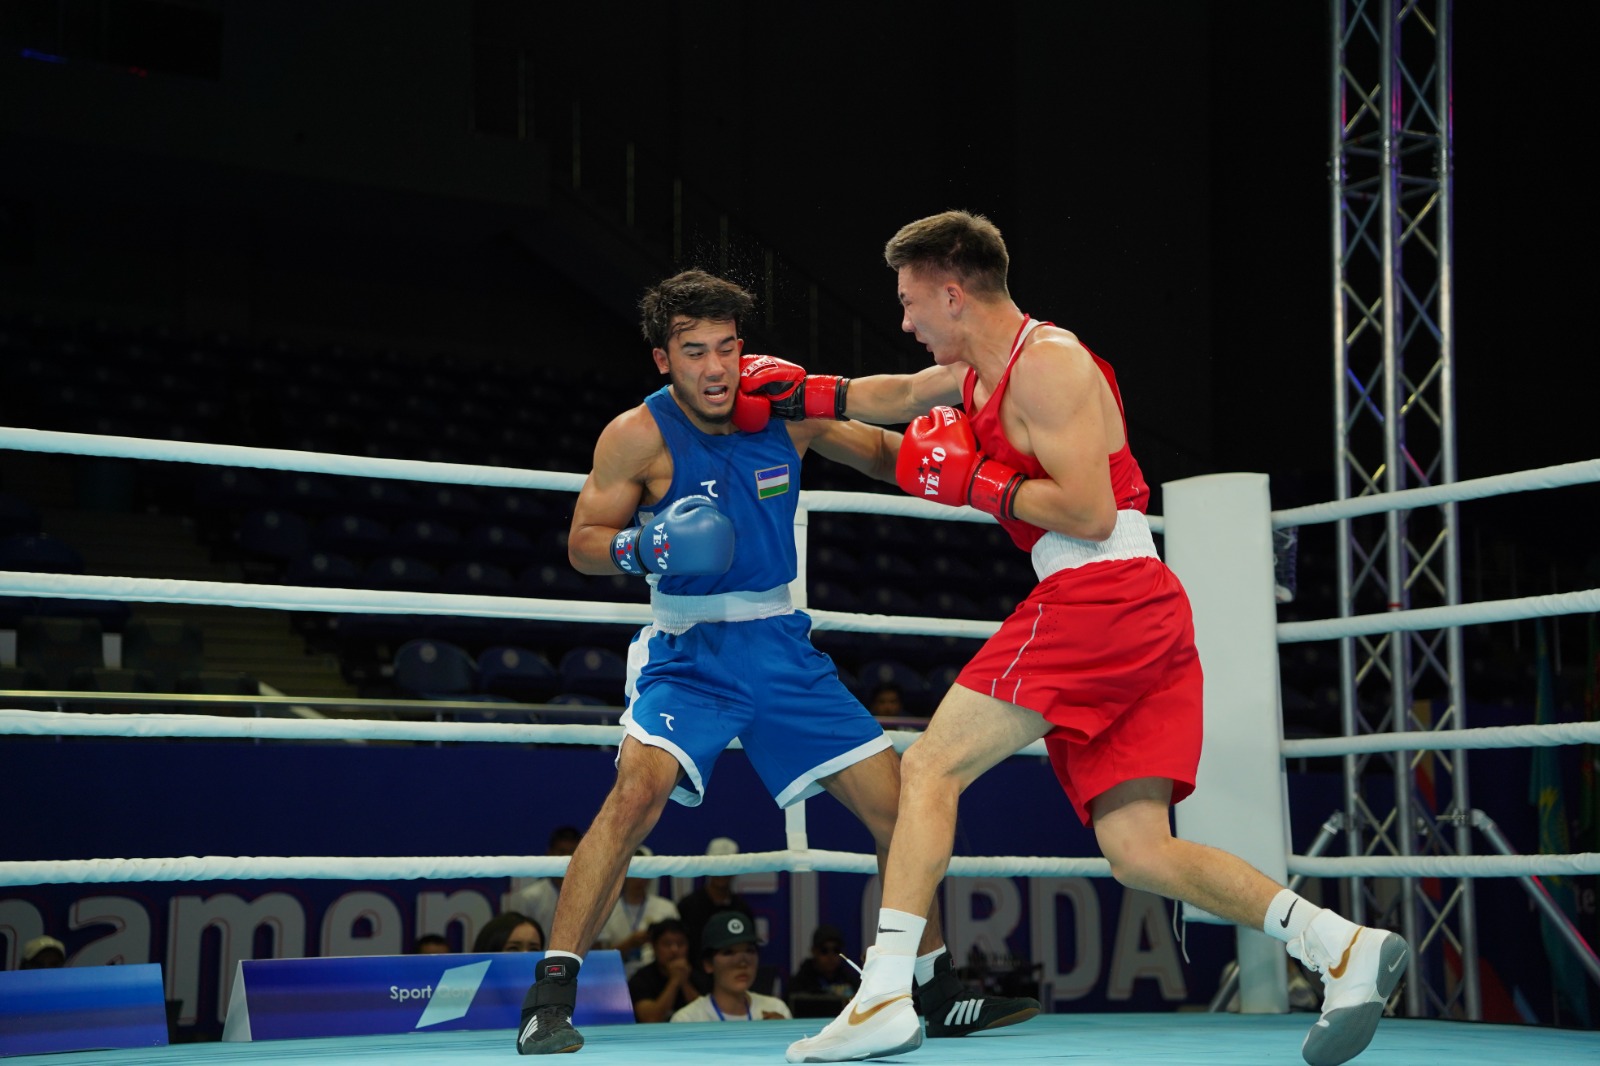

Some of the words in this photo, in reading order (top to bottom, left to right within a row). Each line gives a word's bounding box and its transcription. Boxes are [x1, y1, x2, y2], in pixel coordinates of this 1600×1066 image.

[925, 447, 947, 496] VELO
[653, 522, 668, 570] VELO
[389, 985, 432, 1003] Sport
